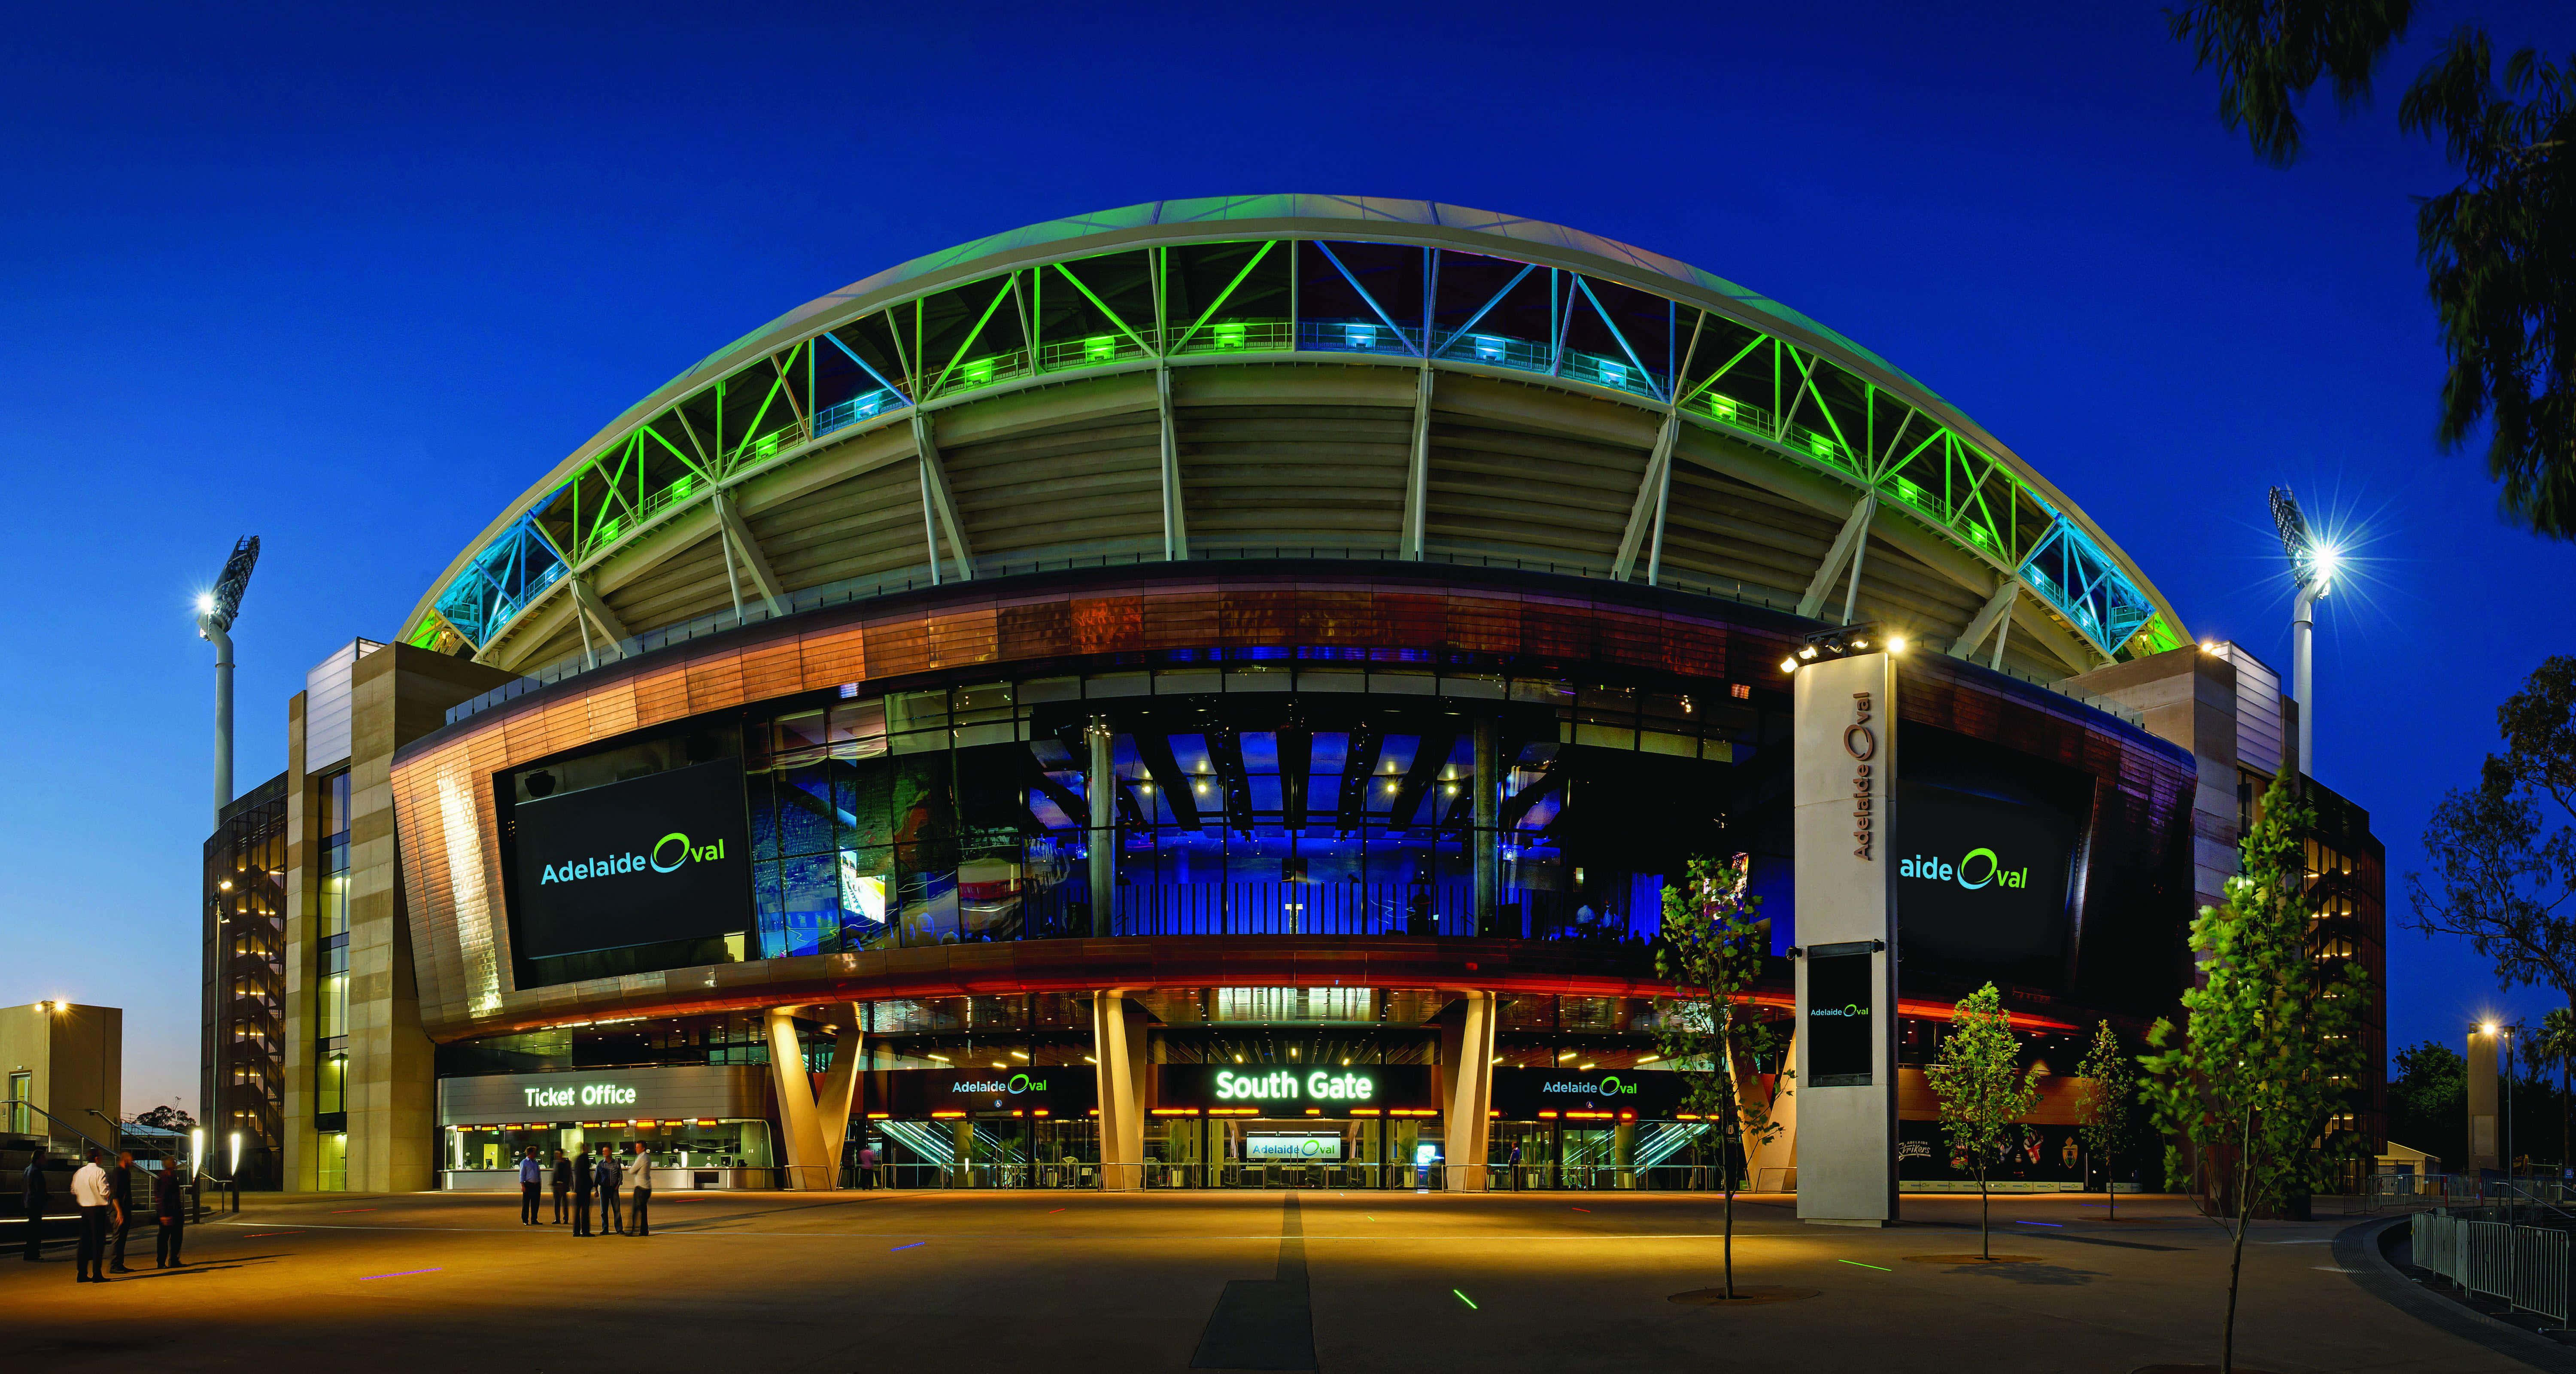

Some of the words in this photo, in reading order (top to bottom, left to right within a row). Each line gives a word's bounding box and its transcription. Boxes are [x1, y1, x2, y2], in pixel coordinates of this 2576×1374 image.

[1844, 692, 1873, 761] Oval
[1853, 764, 1869, 860] Adelaide
[541, 852, 646, 885] Adelaide
[650, 833, 724, 873] Oval
[1900, 854, 1953, 881] aide
[1957, 848, 2028, 890] Oval
[1844, 1004, 1868, 1017] Oval
[525, 1086, 575, 1107] Ticket
[580, 1084, 636, 1106] Office
[952, 1081, 1006, 1092] Adelaide
[1008, 1073, 1046, 1094] Oval
[1216, 1071, 1298, 1098] South
[1307, 1071, 1372, 1099] Gate
[1543, 1082, 1598, 1093] Adelaide
[1600, 1076, 1637, 1096] Oval
[1252, 1145, 1300, 1154] Adelaide
[1301, 1140, 1335, 1156] Oval
